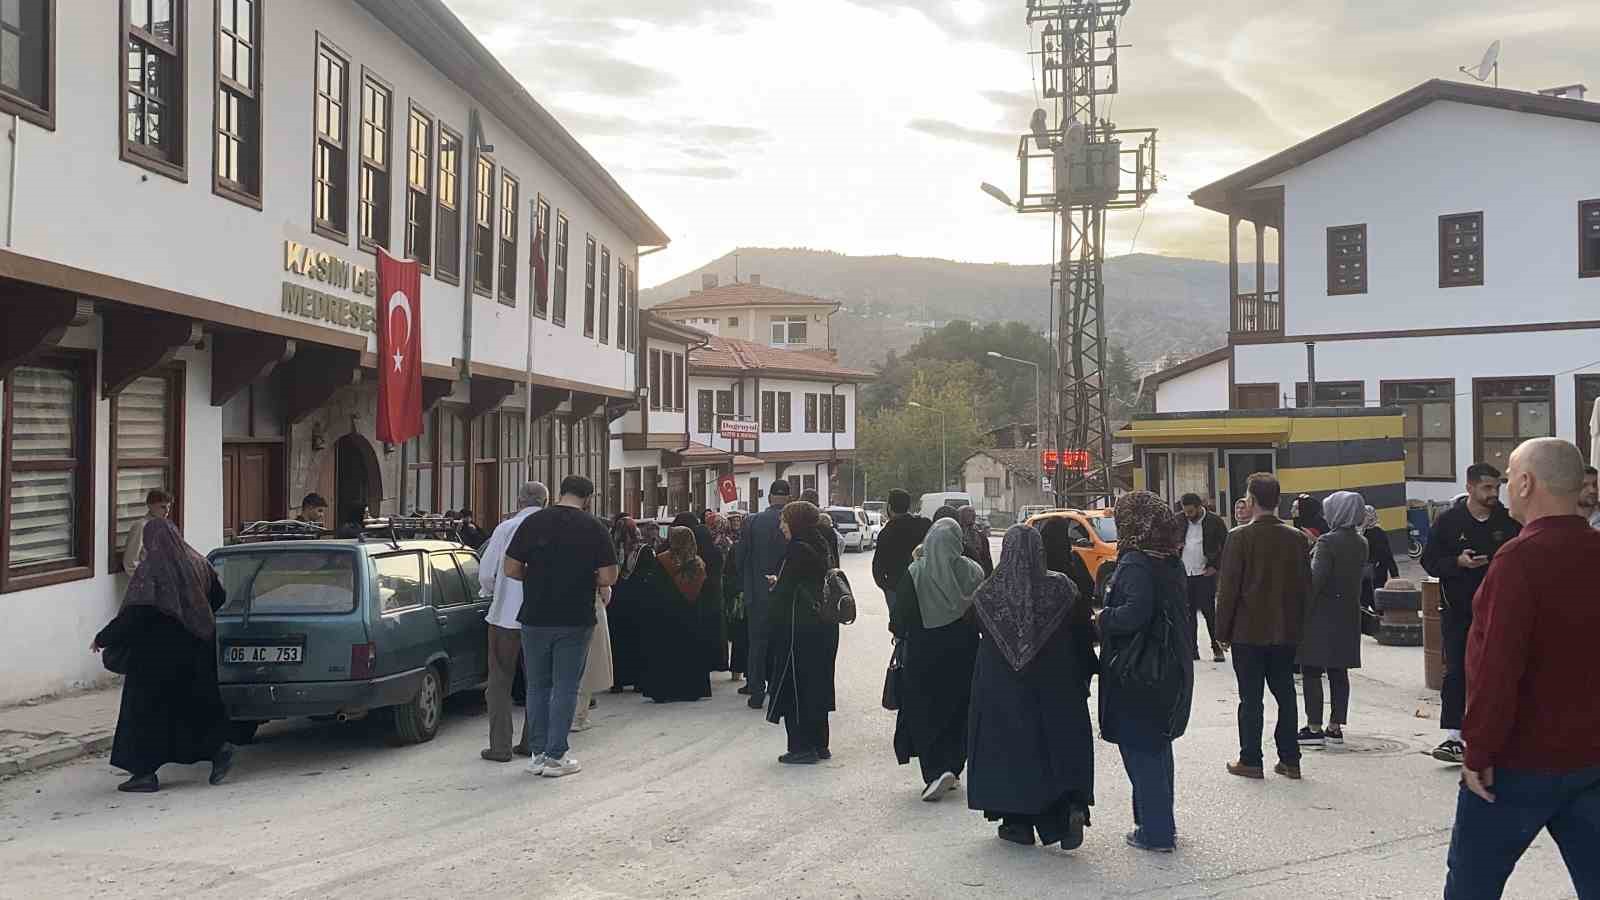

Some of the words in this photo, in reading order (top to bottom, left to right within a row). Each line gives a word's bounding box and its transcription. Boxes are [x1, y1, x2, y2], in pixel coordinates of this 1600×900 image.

[284, 240, 349, 289] KASIM
[352, 265, 377, 298] BE
[281, 281, 377, 333] MEDRESES
[231, 647, 245, 661] 06
[252, 648, 266, 661] AC
[276, 647, 298, 661] 753
